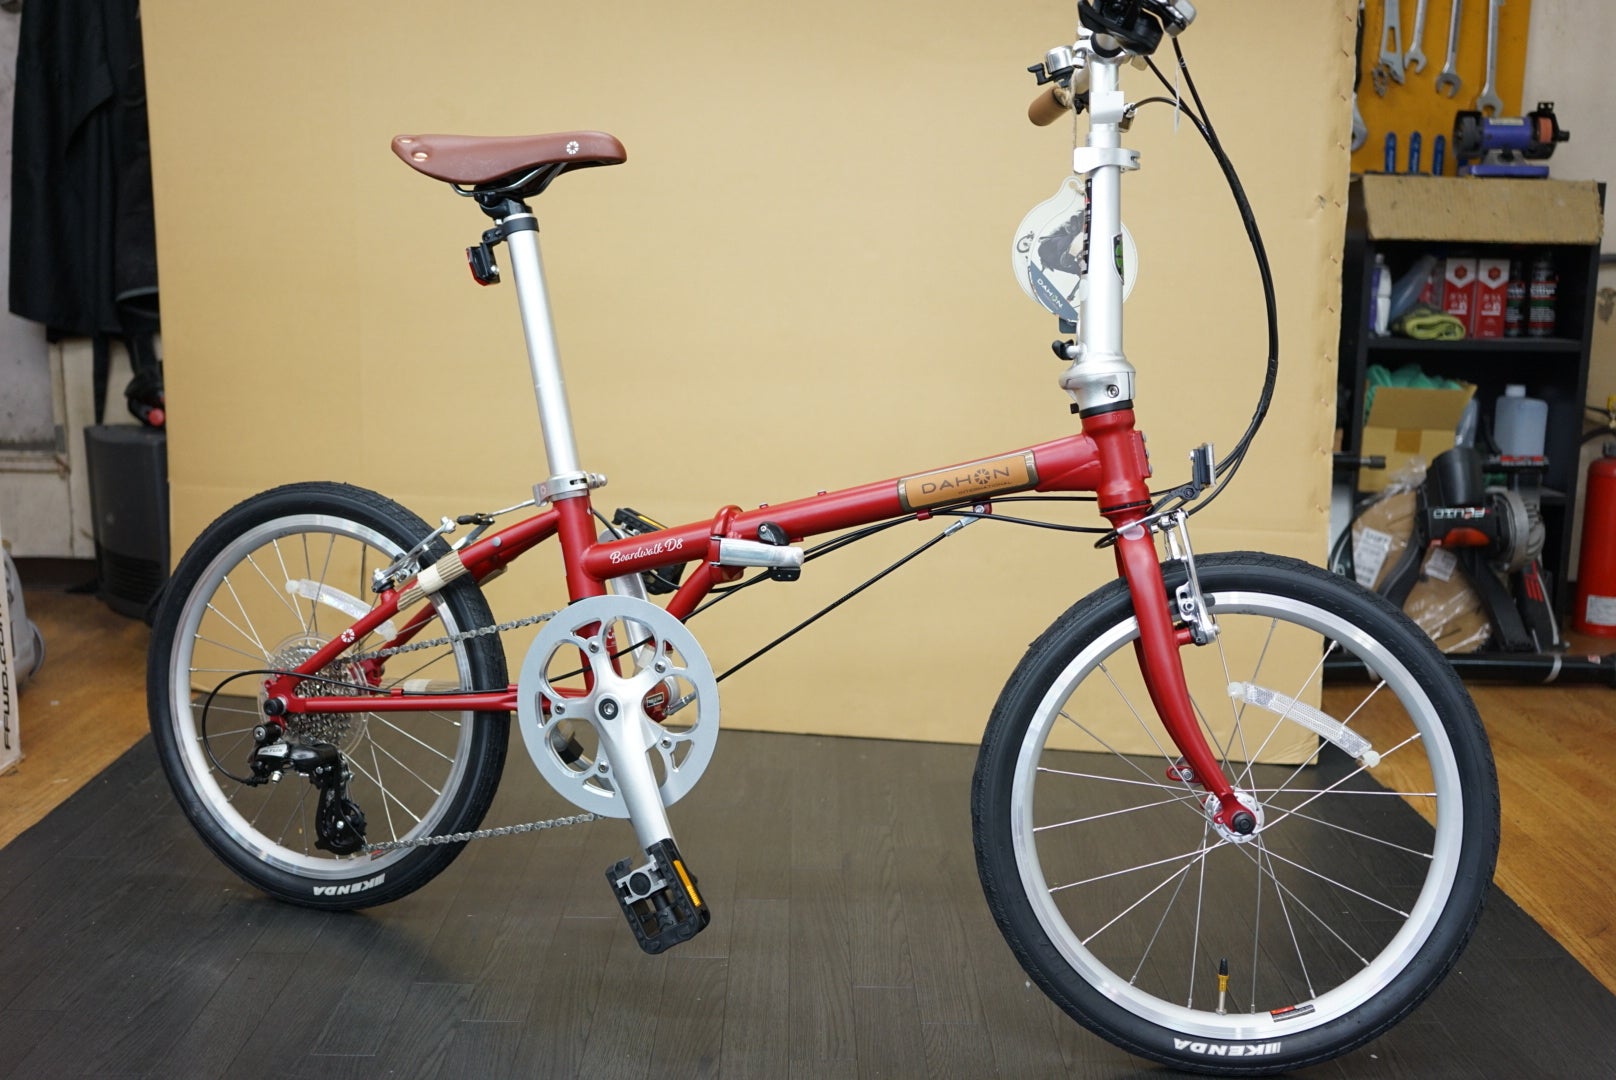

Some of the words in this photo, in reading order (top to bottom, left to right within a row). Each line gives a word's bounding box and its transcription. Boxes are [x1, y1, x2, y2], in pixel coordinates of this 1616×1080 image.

[1037, 278, 1063, 308] DAHON
[921, 467, 1010, 494] DAHON
[609, 543, 664, 564] Boardwalk
[664, 538, 684, 552] D8
[0, 604, 11, 749] FFWD.CO
[313, 875, 378, 895] KENDA
[1173, 1038, 1273, 1056] KENDA
